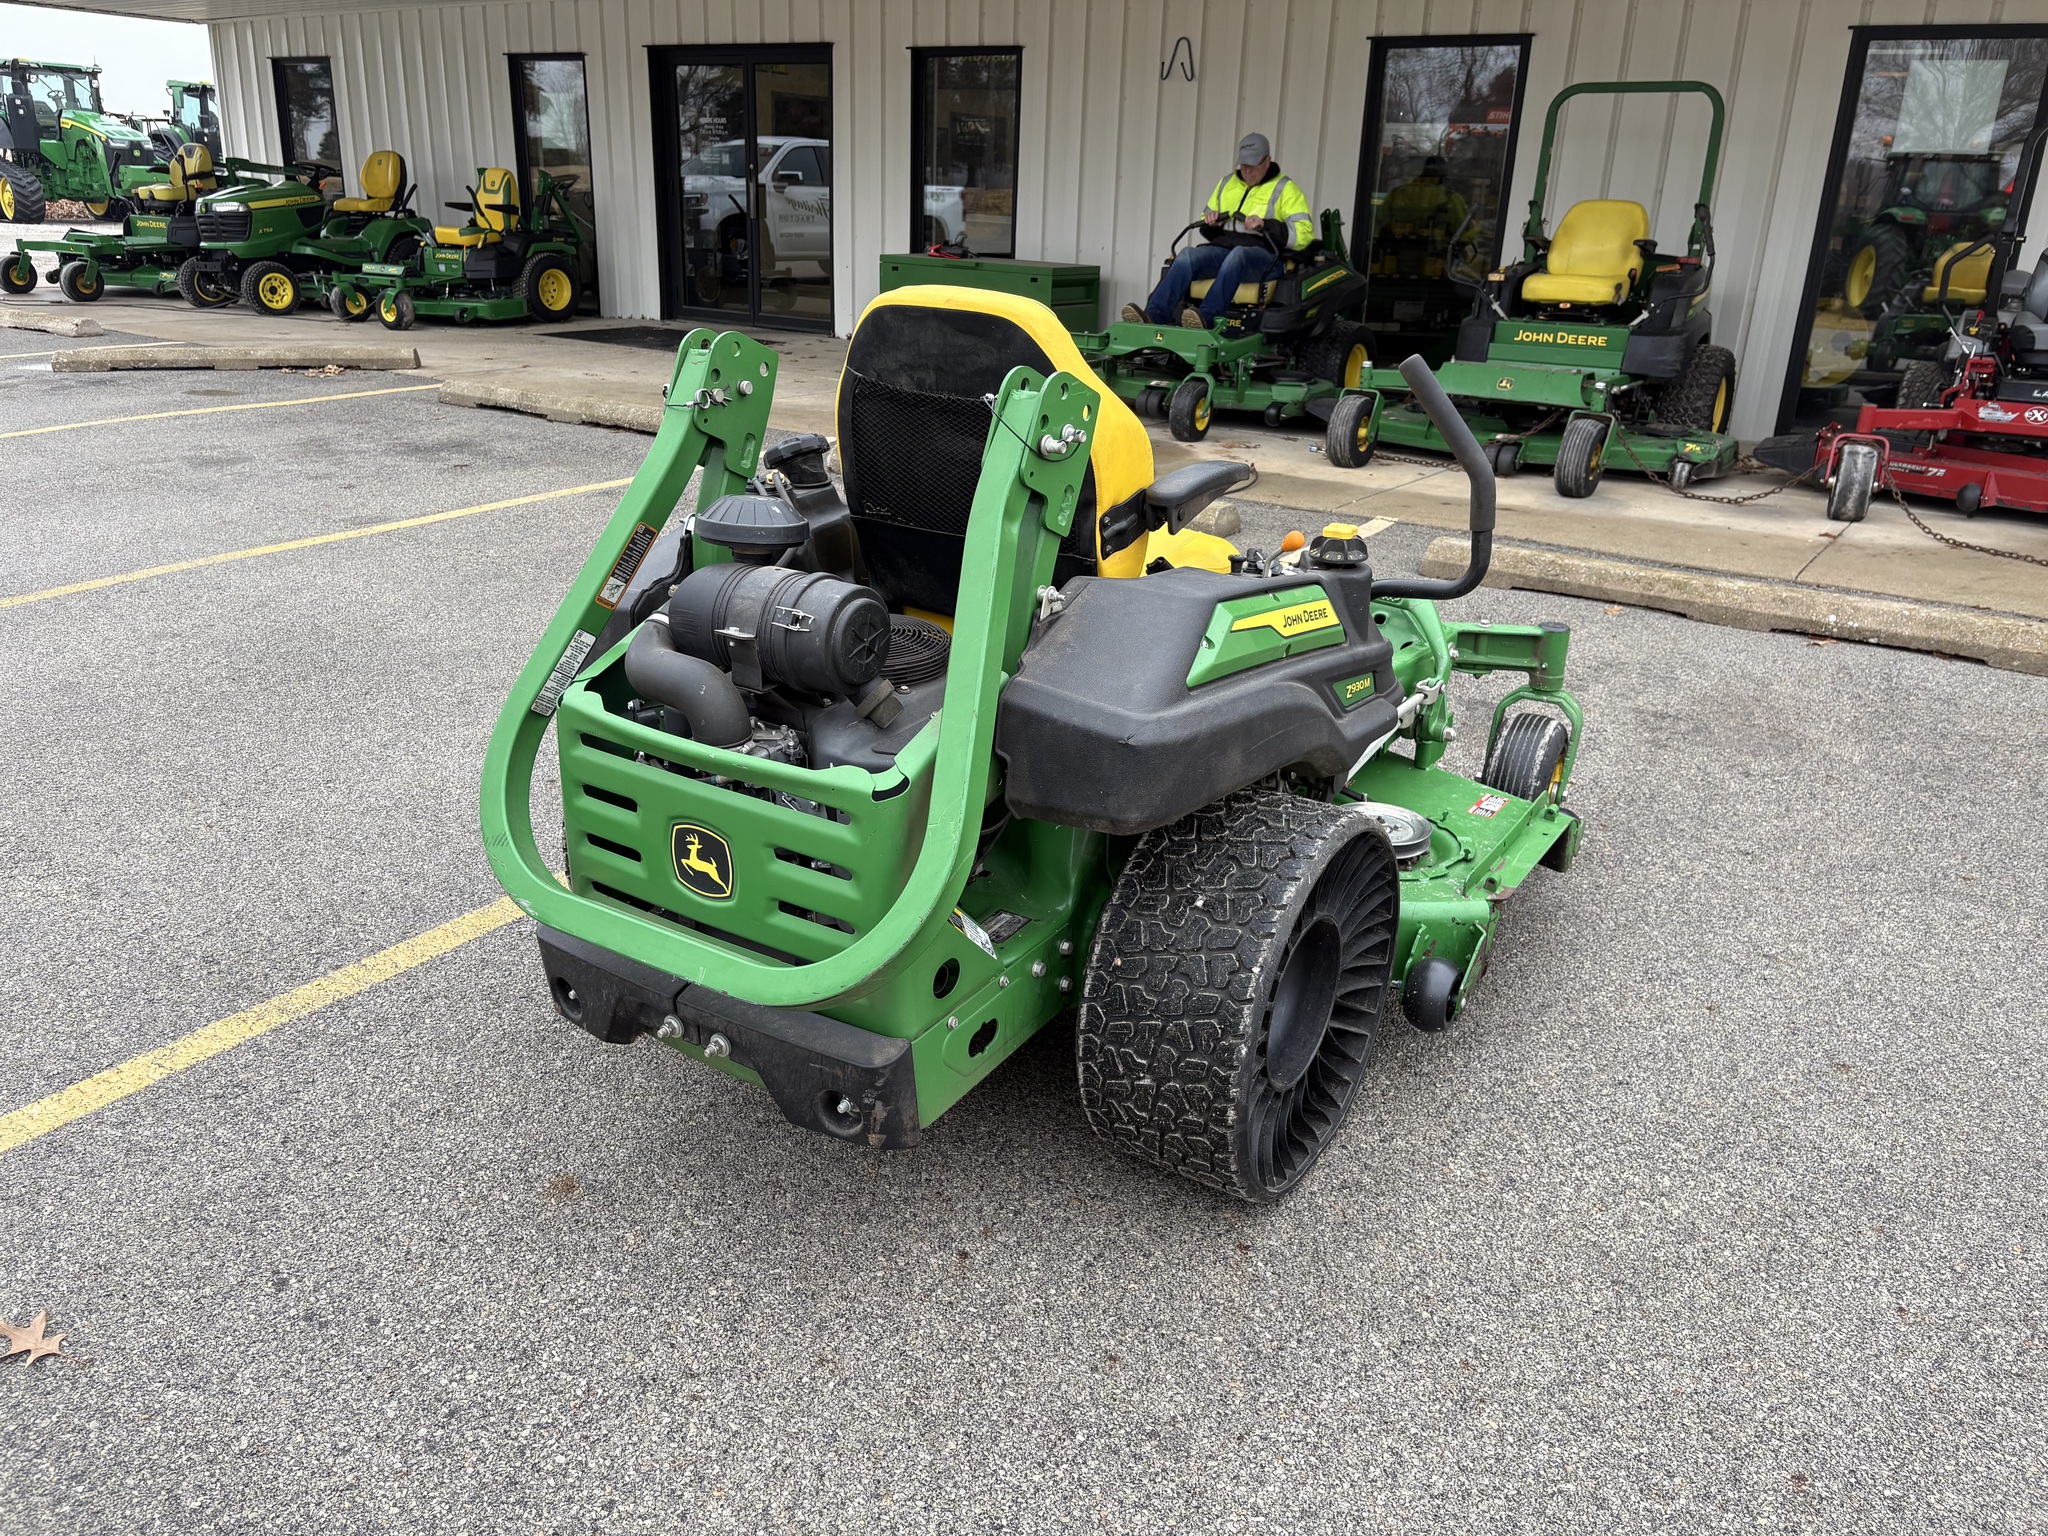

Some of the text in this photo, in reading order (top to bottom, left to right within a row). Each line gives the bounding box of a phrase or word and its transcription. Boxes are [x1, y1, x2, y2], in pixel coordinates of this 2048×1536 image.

[1487, 111, 1510, 120] STIH
[136, 219, 167, 229] JOHN DEERE
[1513, 329, 1608, 347] JOHN DEERE
[1283, 608, 1328, 628] JOHN DEERE
[1345, 677, 1371, 699] Z930M
